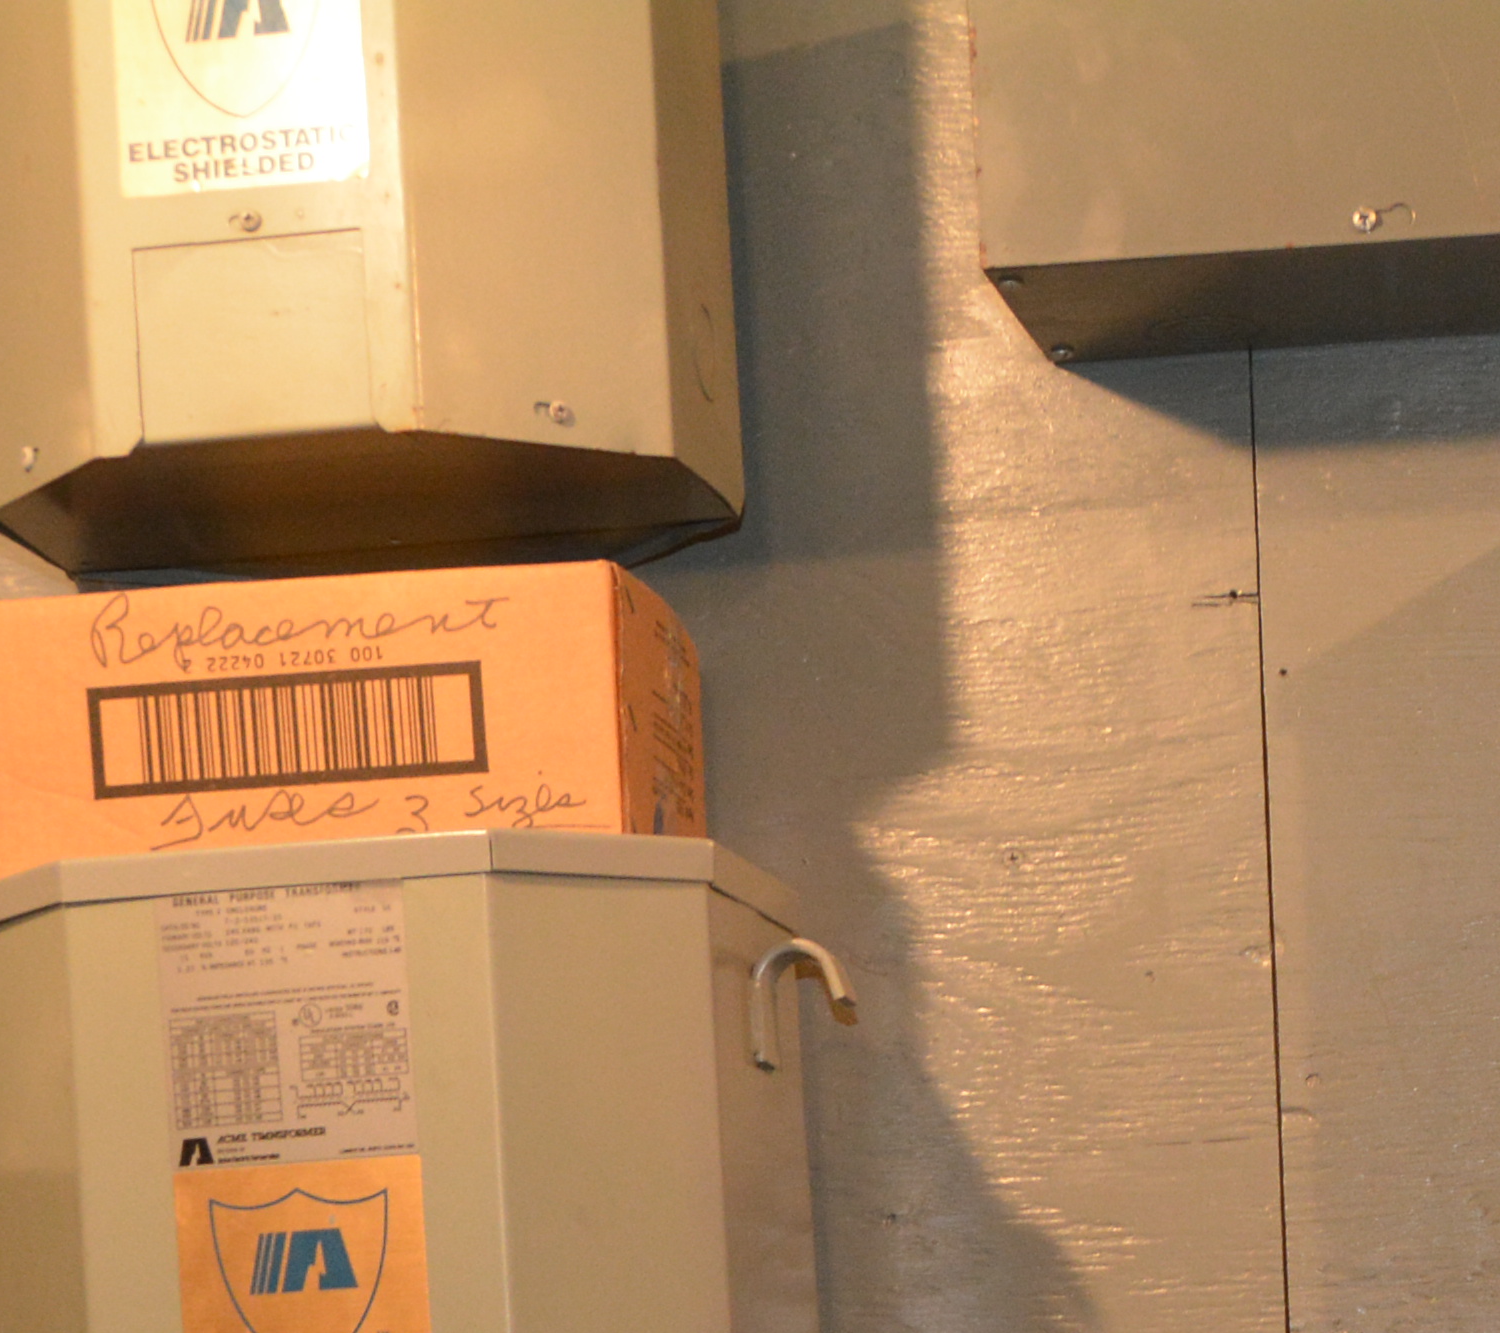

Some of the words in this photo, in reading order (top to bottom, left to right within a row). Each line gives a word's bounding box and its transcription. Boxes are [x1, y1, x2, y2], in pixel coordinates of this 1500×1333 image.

[128, 124, 356, 163] ELECTROSTATIC
[173, 152, 315, 183] SHIELDED
[90, 590, 510, 670] Replacement
[206, 652, 264, 673] 04222
[279, 648, 336, 666] 30721
[350, 645, 383, 661] 100
[229, 888, 275, 901] PURPOSE
[217, 1132, 248, 1145] ACME
[251, 1126, 327, 1142] TRANSFORMER
